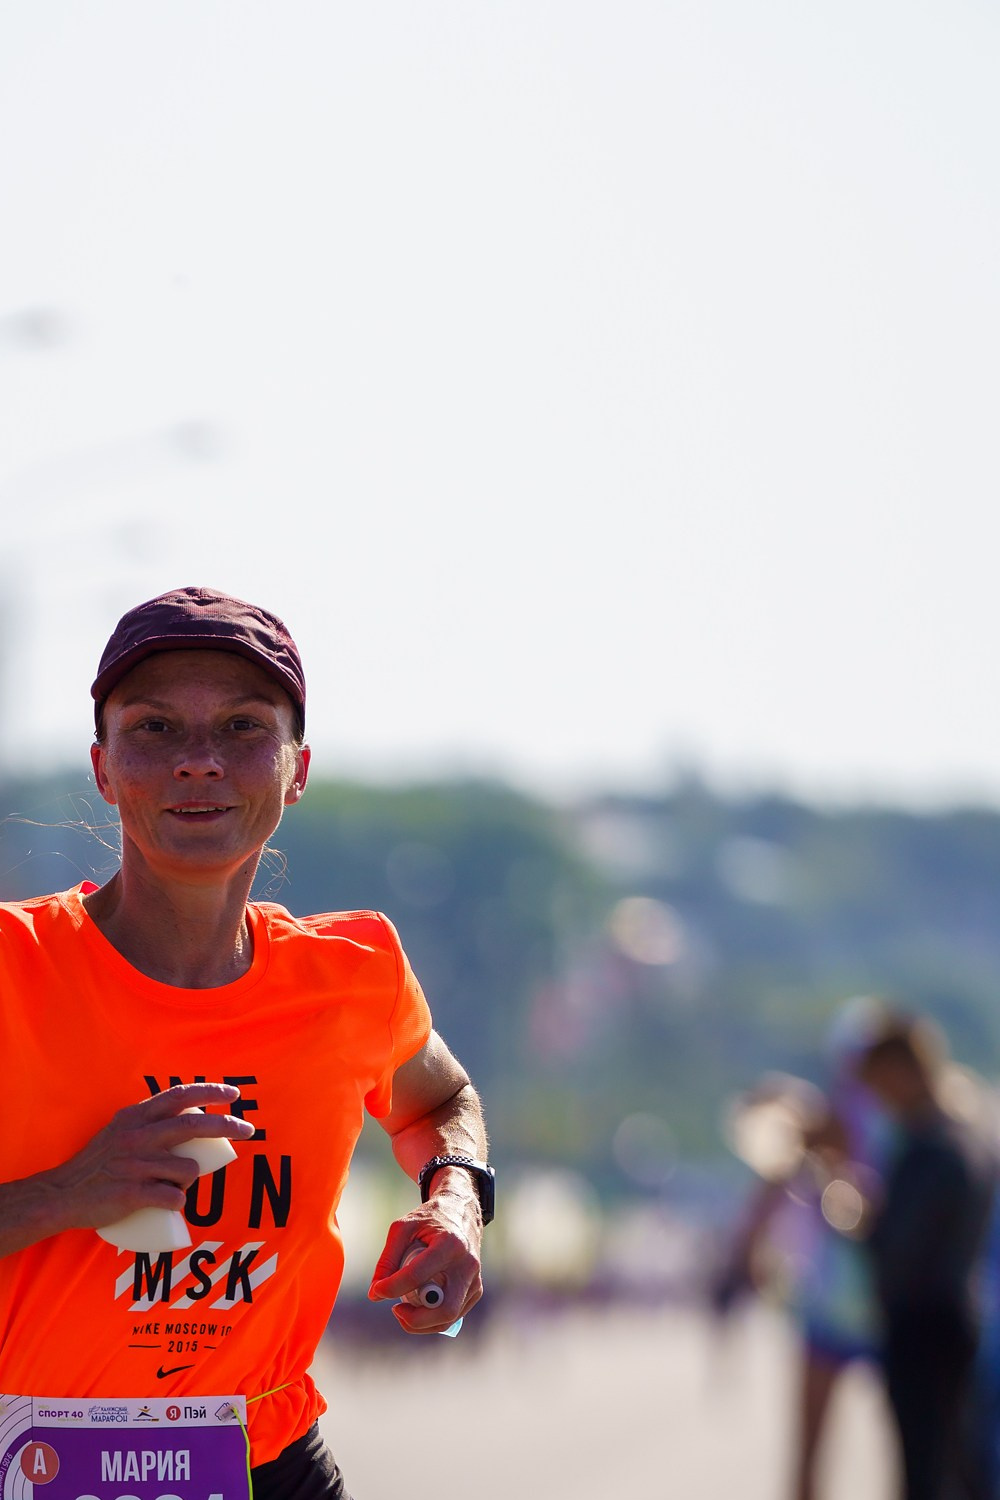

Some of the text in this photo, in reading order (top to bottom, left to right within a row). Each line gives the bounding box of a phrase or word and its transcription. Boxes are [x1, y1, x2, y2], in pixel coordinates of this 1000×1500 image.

[143, 1075, 266, 1141] E
[184, 1154, 292, 1229] UN
[132, 1249, 260, 1304] MSK
[132, 1322, 160, 1335] NIKE
[165, 1323, 218, 1336] MOSCOW
[168, 1340, 198, 1353] 2015
[38, 1410, 70, 1418] СПОРТ
[169, 1406, 207, 1419] Я Пэй
[101, 1449, 190, 1482] МАРИЯ
